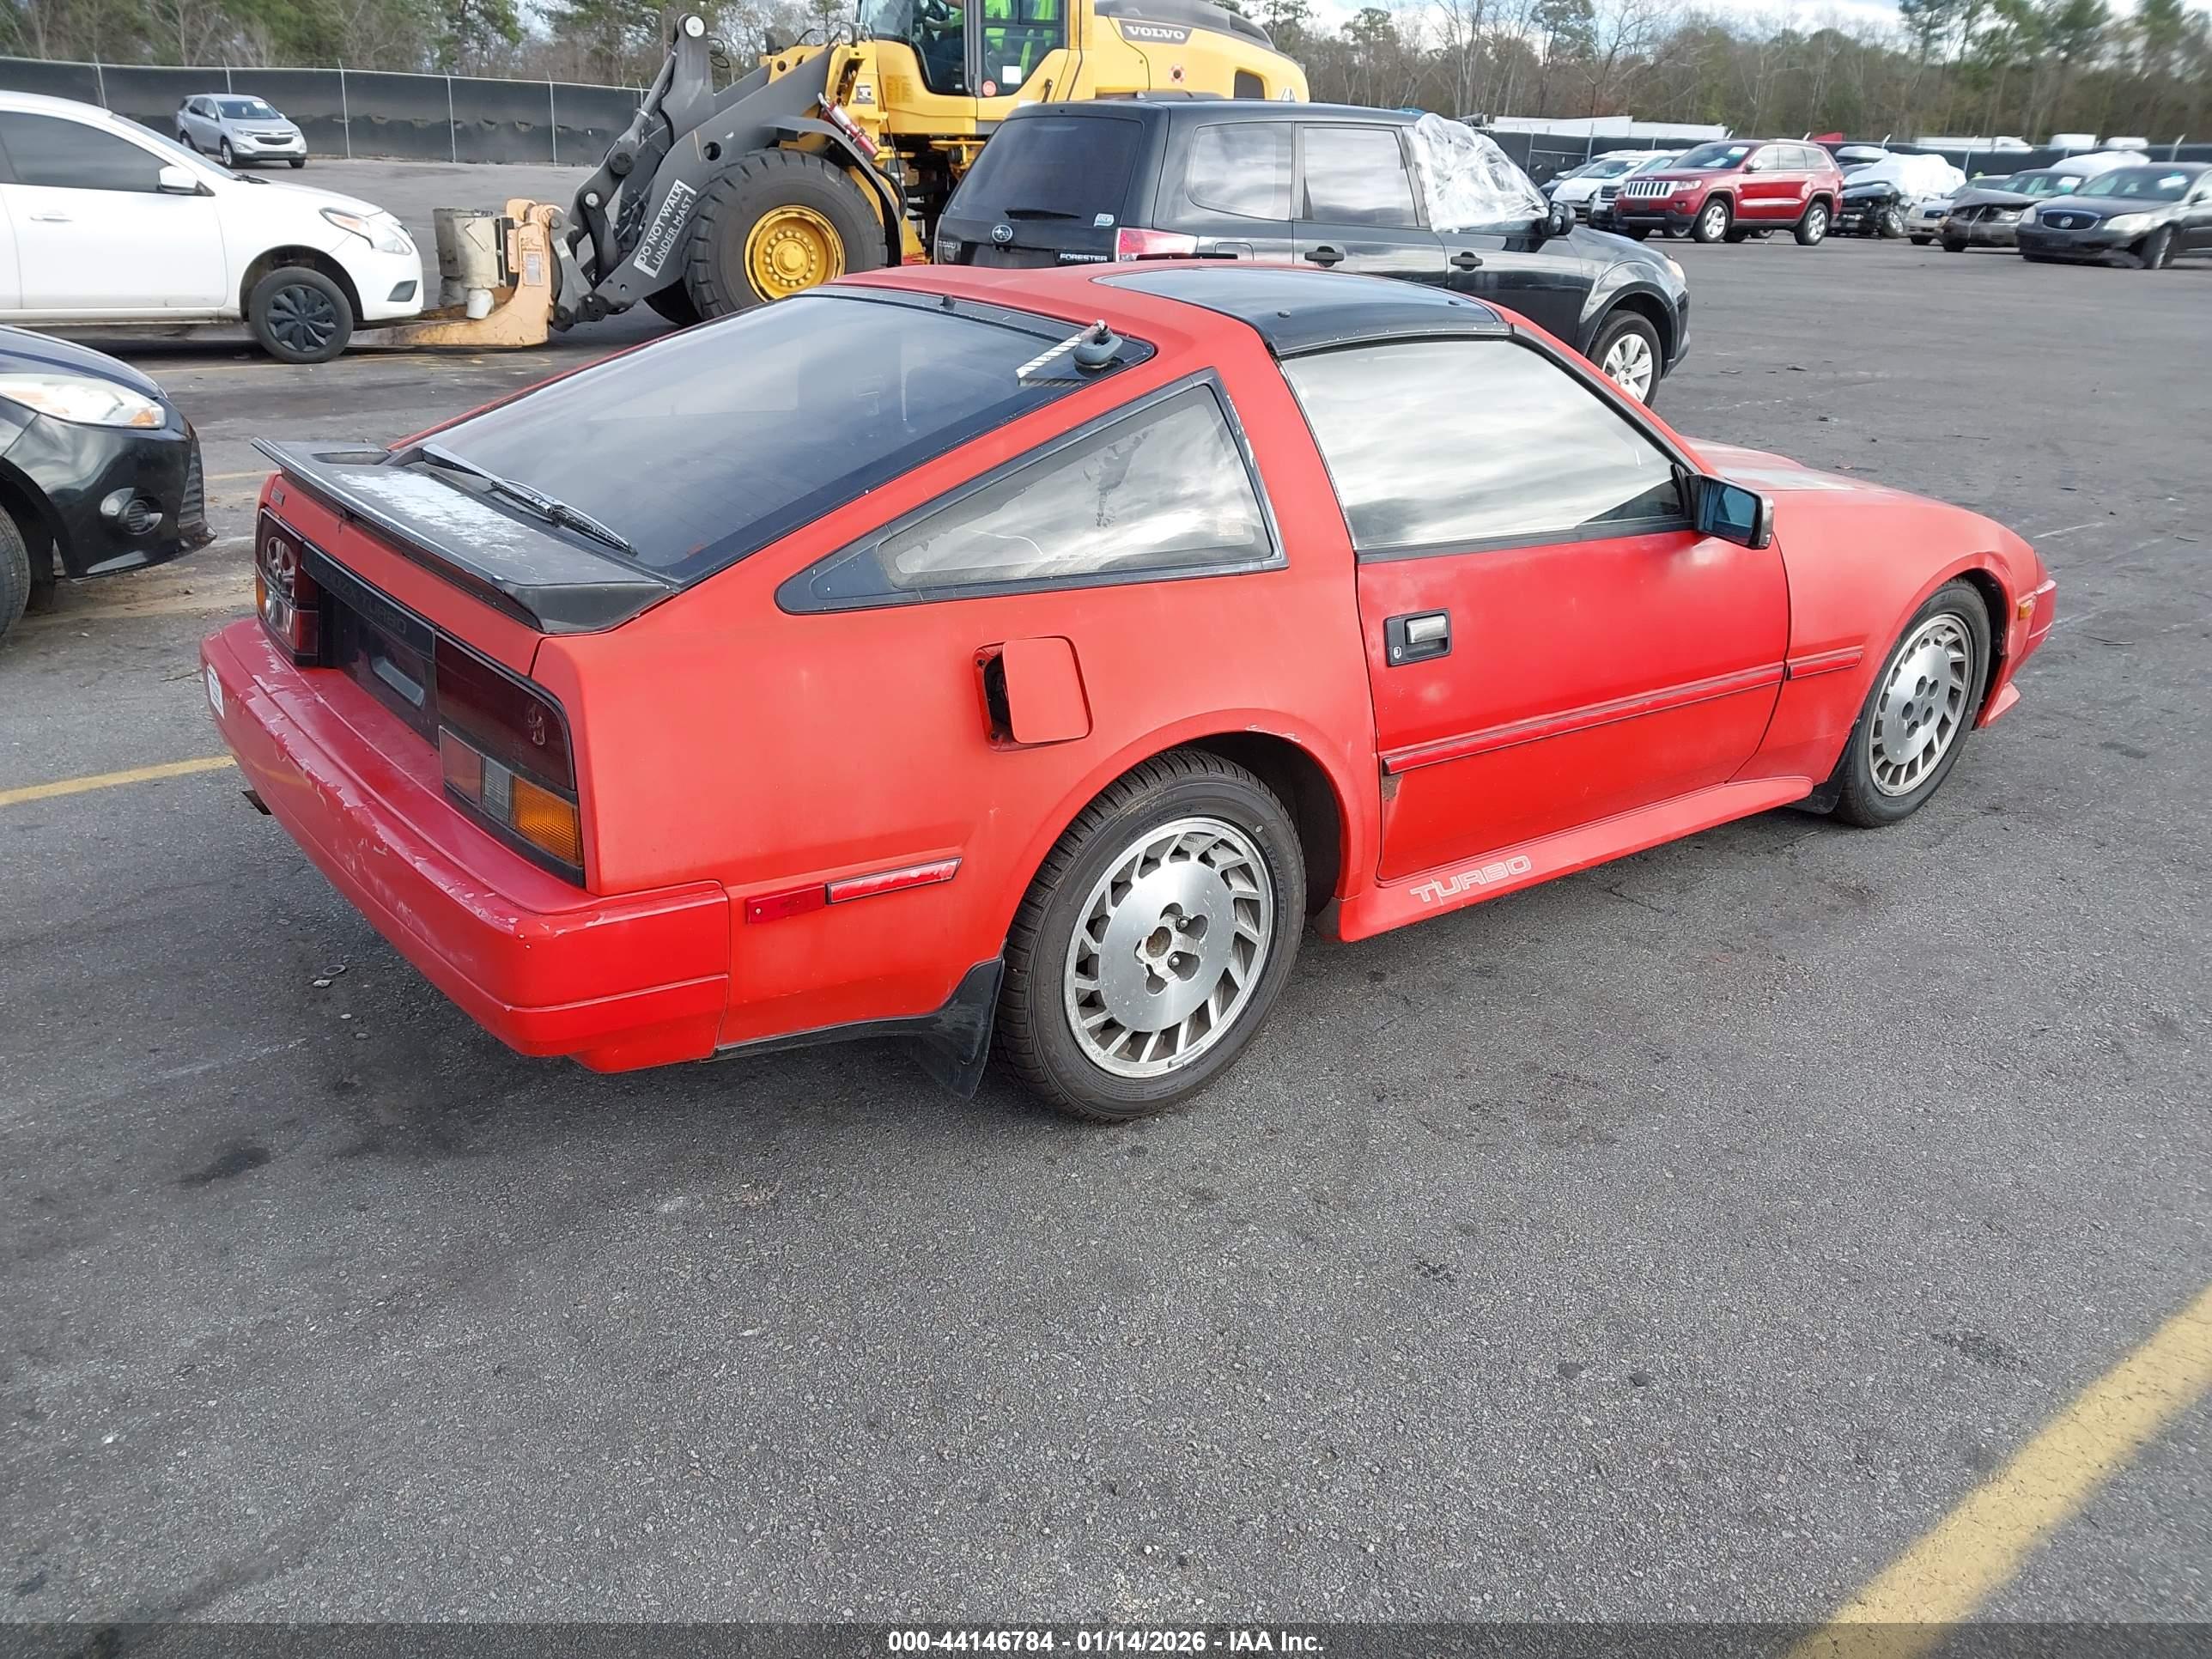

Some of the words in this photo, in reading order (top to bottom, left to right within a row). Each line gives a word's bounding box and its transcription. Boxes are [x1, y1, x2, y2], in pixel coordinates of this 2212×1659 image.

[1125, 25, 1186, 40] VOLVO
[638, 246, 652, 264] DO
[647, 218, 665, 246] NOT
[661, 184, 684, 218] WALK
[652, 227, 678, 264] UNDER
[673, 195, 693, 227] MAST
[1059, 252, 1108, 262] FORESTER
[1409, 854, 1532, 902] TURBO
